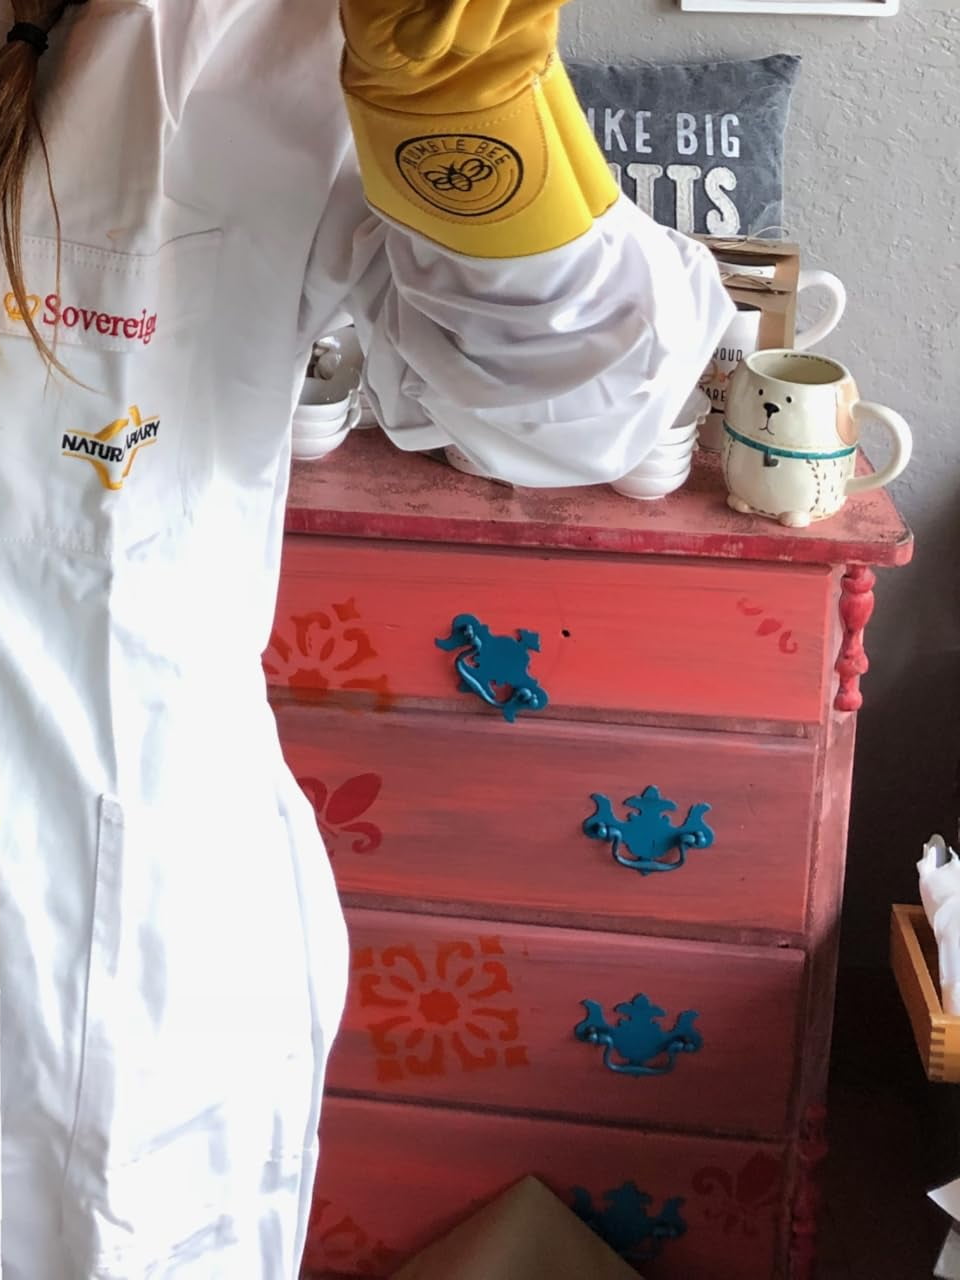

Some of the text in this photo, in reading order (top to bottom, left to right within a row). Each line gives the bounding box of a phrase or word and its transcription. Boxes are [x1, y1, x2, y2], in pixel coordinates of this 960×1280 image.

[587, 107, 740, 158] IKE BIG
[402, 139, 512, 168] HUMBLE BEE
[607, 162, 741, 236] TTS
[43, 293, 158, 345] Sovereig
[711, 347, 743, 362] ROUD
[61, 433, 125, 463] NATUR
